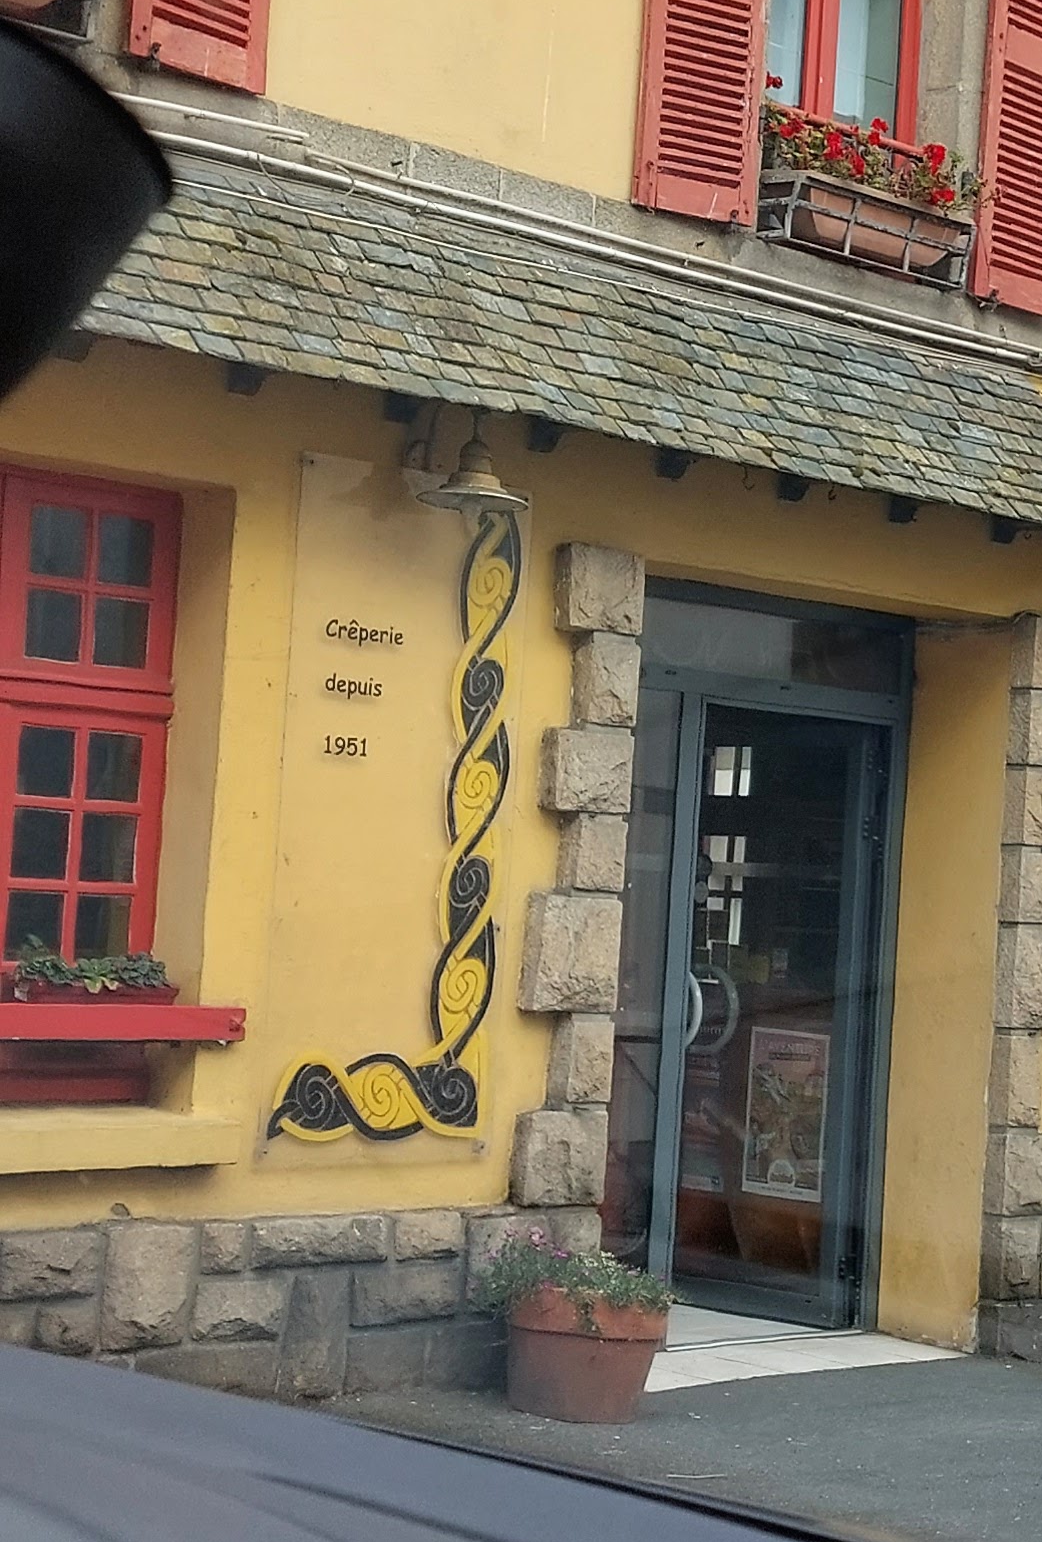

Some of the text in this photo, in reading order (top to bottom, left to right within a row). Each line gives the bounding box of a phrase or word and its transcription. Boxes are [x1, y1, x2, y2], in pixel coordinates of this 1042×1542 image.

[325, 619, 404, 647] Crêperie
[325, 672, 383, 700] depuis
[323, 735, 368, 757] 1951
